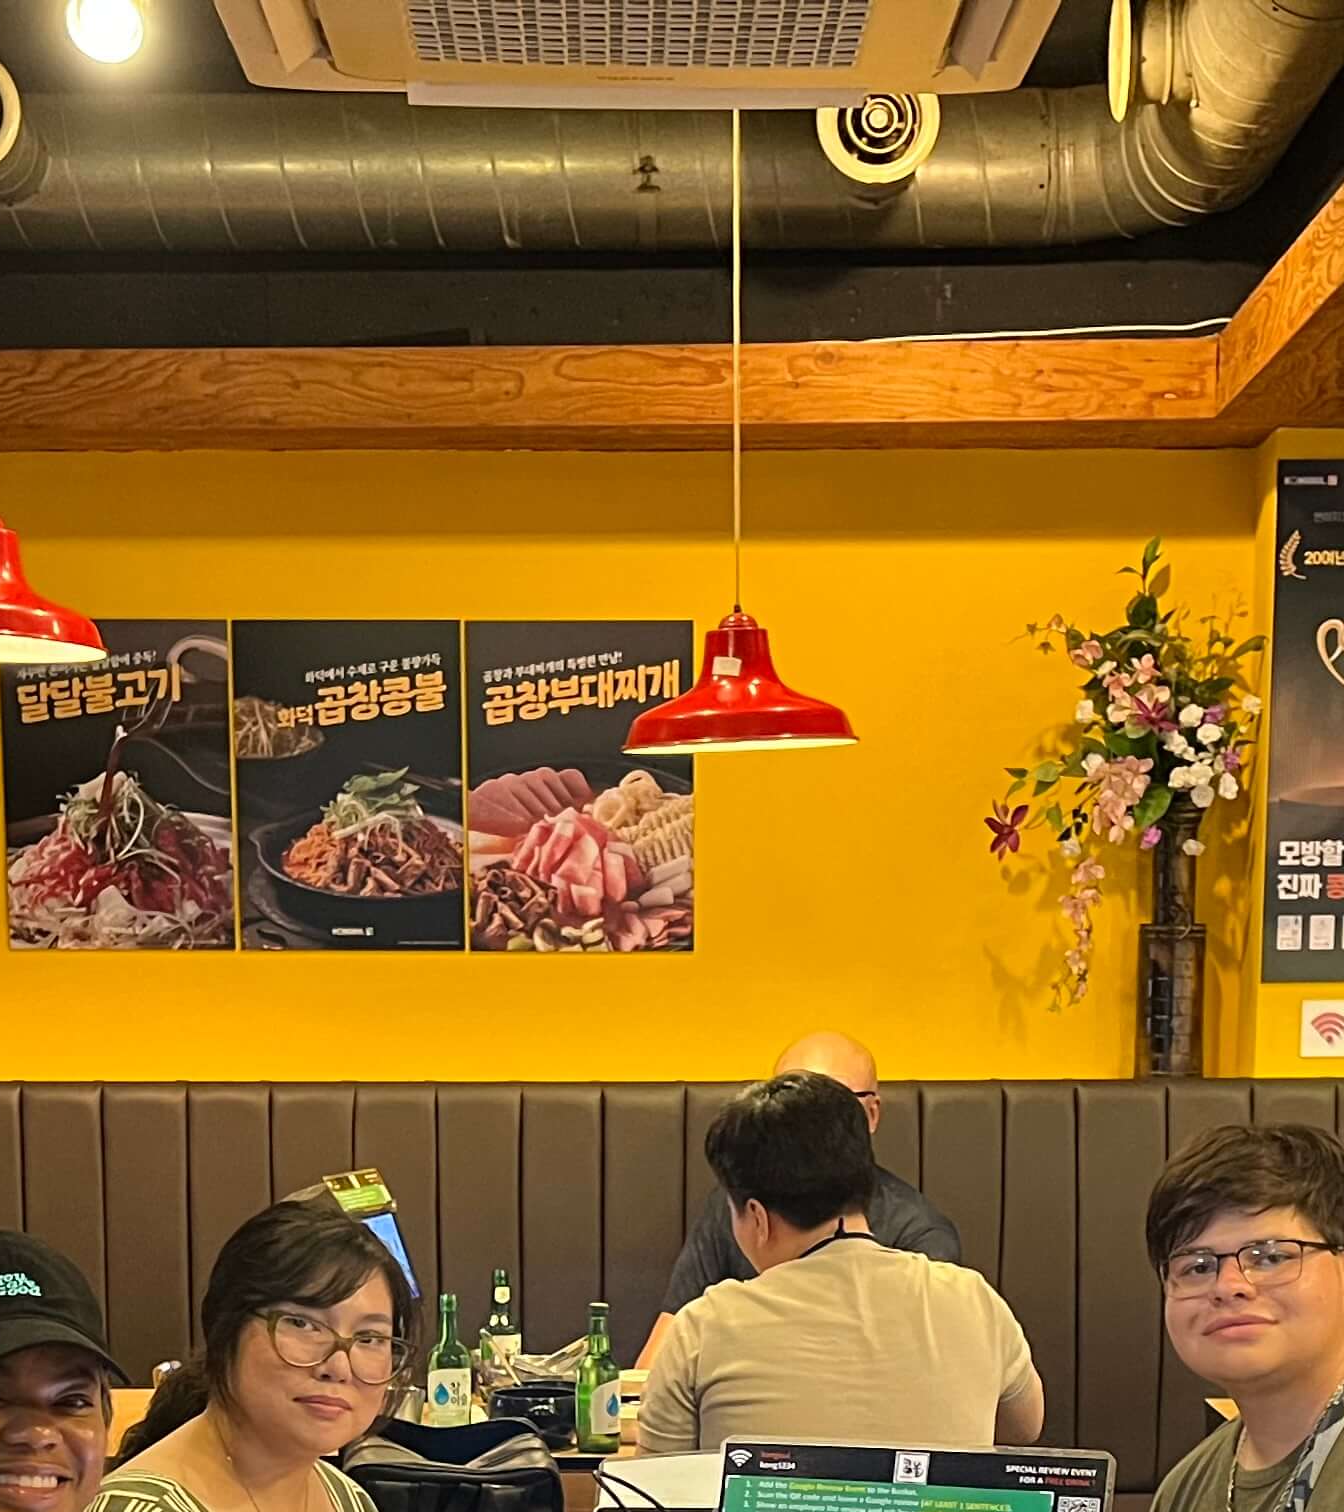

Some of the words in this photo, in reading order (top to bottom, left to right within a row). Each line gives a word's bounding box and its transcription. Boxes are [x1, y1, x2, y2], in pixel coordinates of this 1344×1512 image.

[16, 662, 182, 725] 달달불고기
[277, 704, 315, 728] 화덕
[314, 670, 447, 726] 곱창콩불
[482, 659, 681, 726] 곱창부대찌개
[1277, 839, 1344, 867] 모방할
[1276, 872, 1322, 900] 진짜
[1005, 1465, 1038, 1474] SPECIAL
[1038, 1466, 1070, 1475] REVIEW
[1071, 1468, 1097, 1477] EVENT
[1019, 1476, 1036, 1484] FOR
